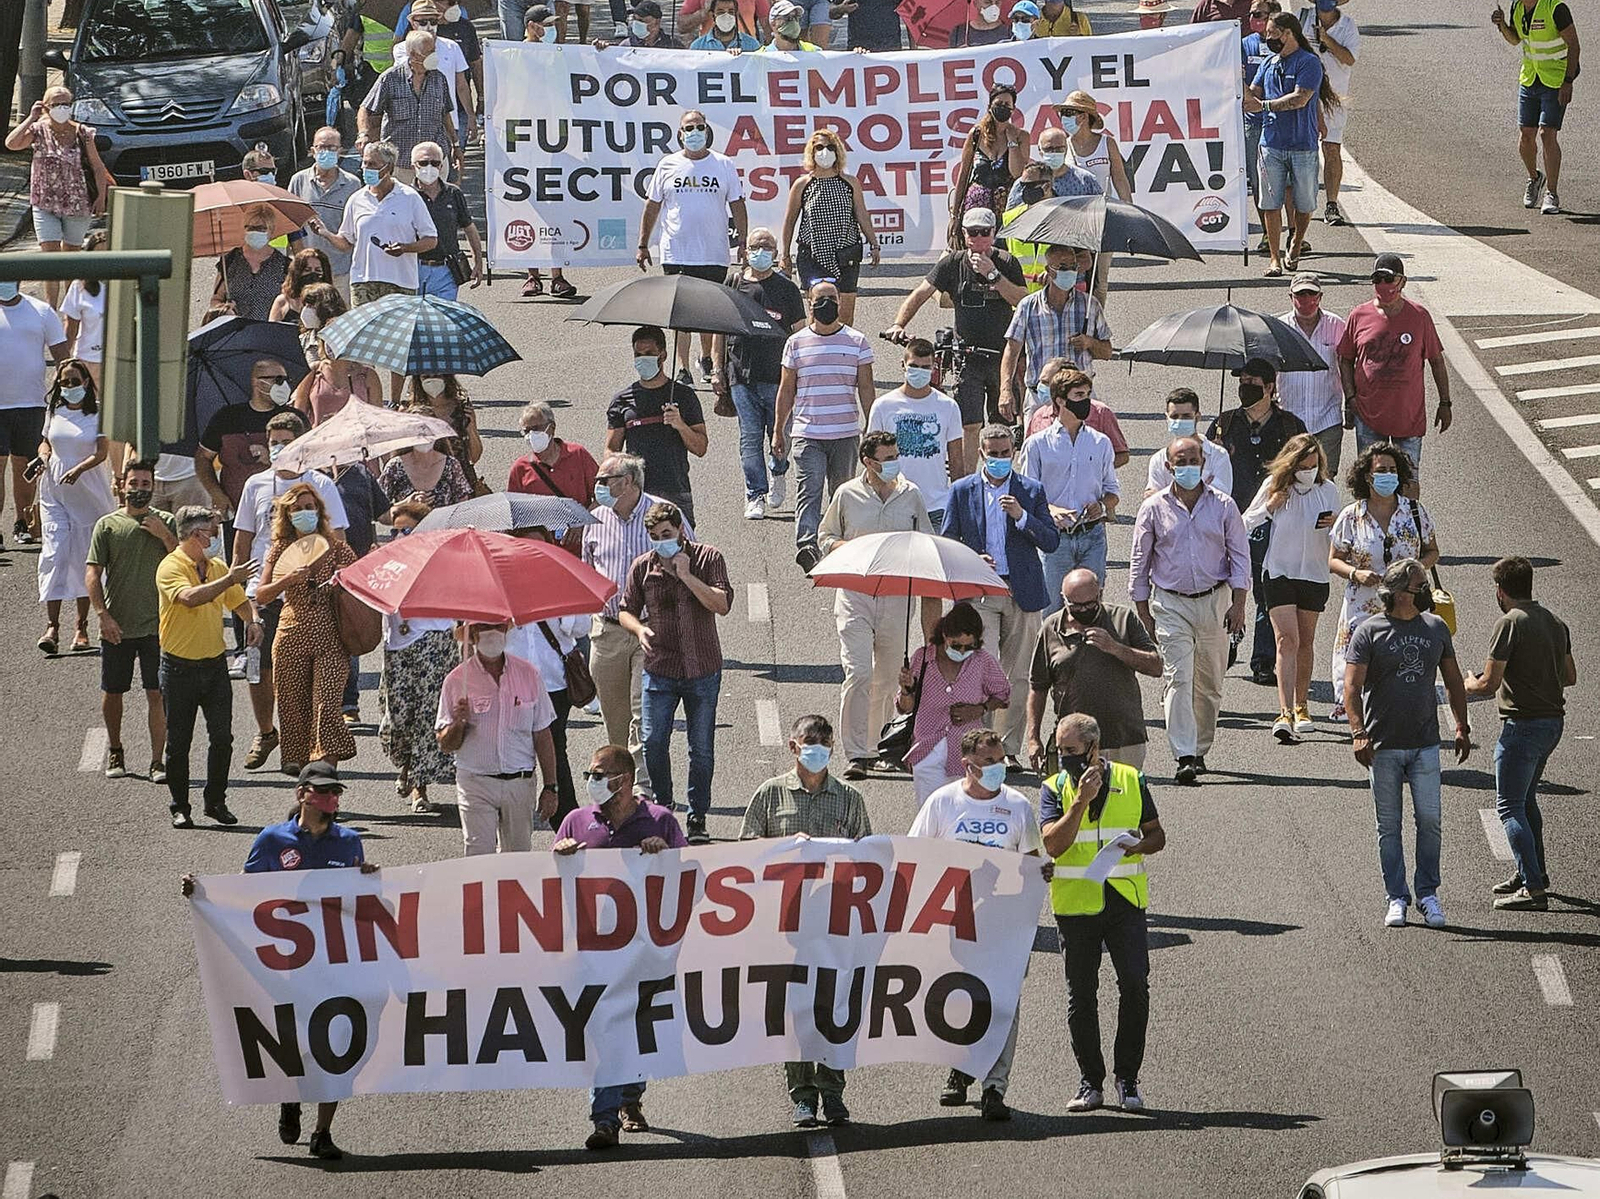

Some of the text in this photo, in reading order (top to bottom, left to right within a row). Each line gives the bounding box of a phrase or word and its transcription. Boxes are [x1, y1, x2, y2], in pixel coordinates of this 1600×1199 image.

[570, 53, 1150, 108] POR EL EMPLEO Y EL
[150, 165, 183, 180] 1960
[673, 176, 720, 189] SALSA
[1200, 213, 1223, 225] CGT
[539, 227, 562, 237] FICA
[955, 821, 1008, 835] A380
[253, 861, 977, 971] SIN INDUSTRIA
[233, 964, 993, 1079] NO HAY FUTURO
